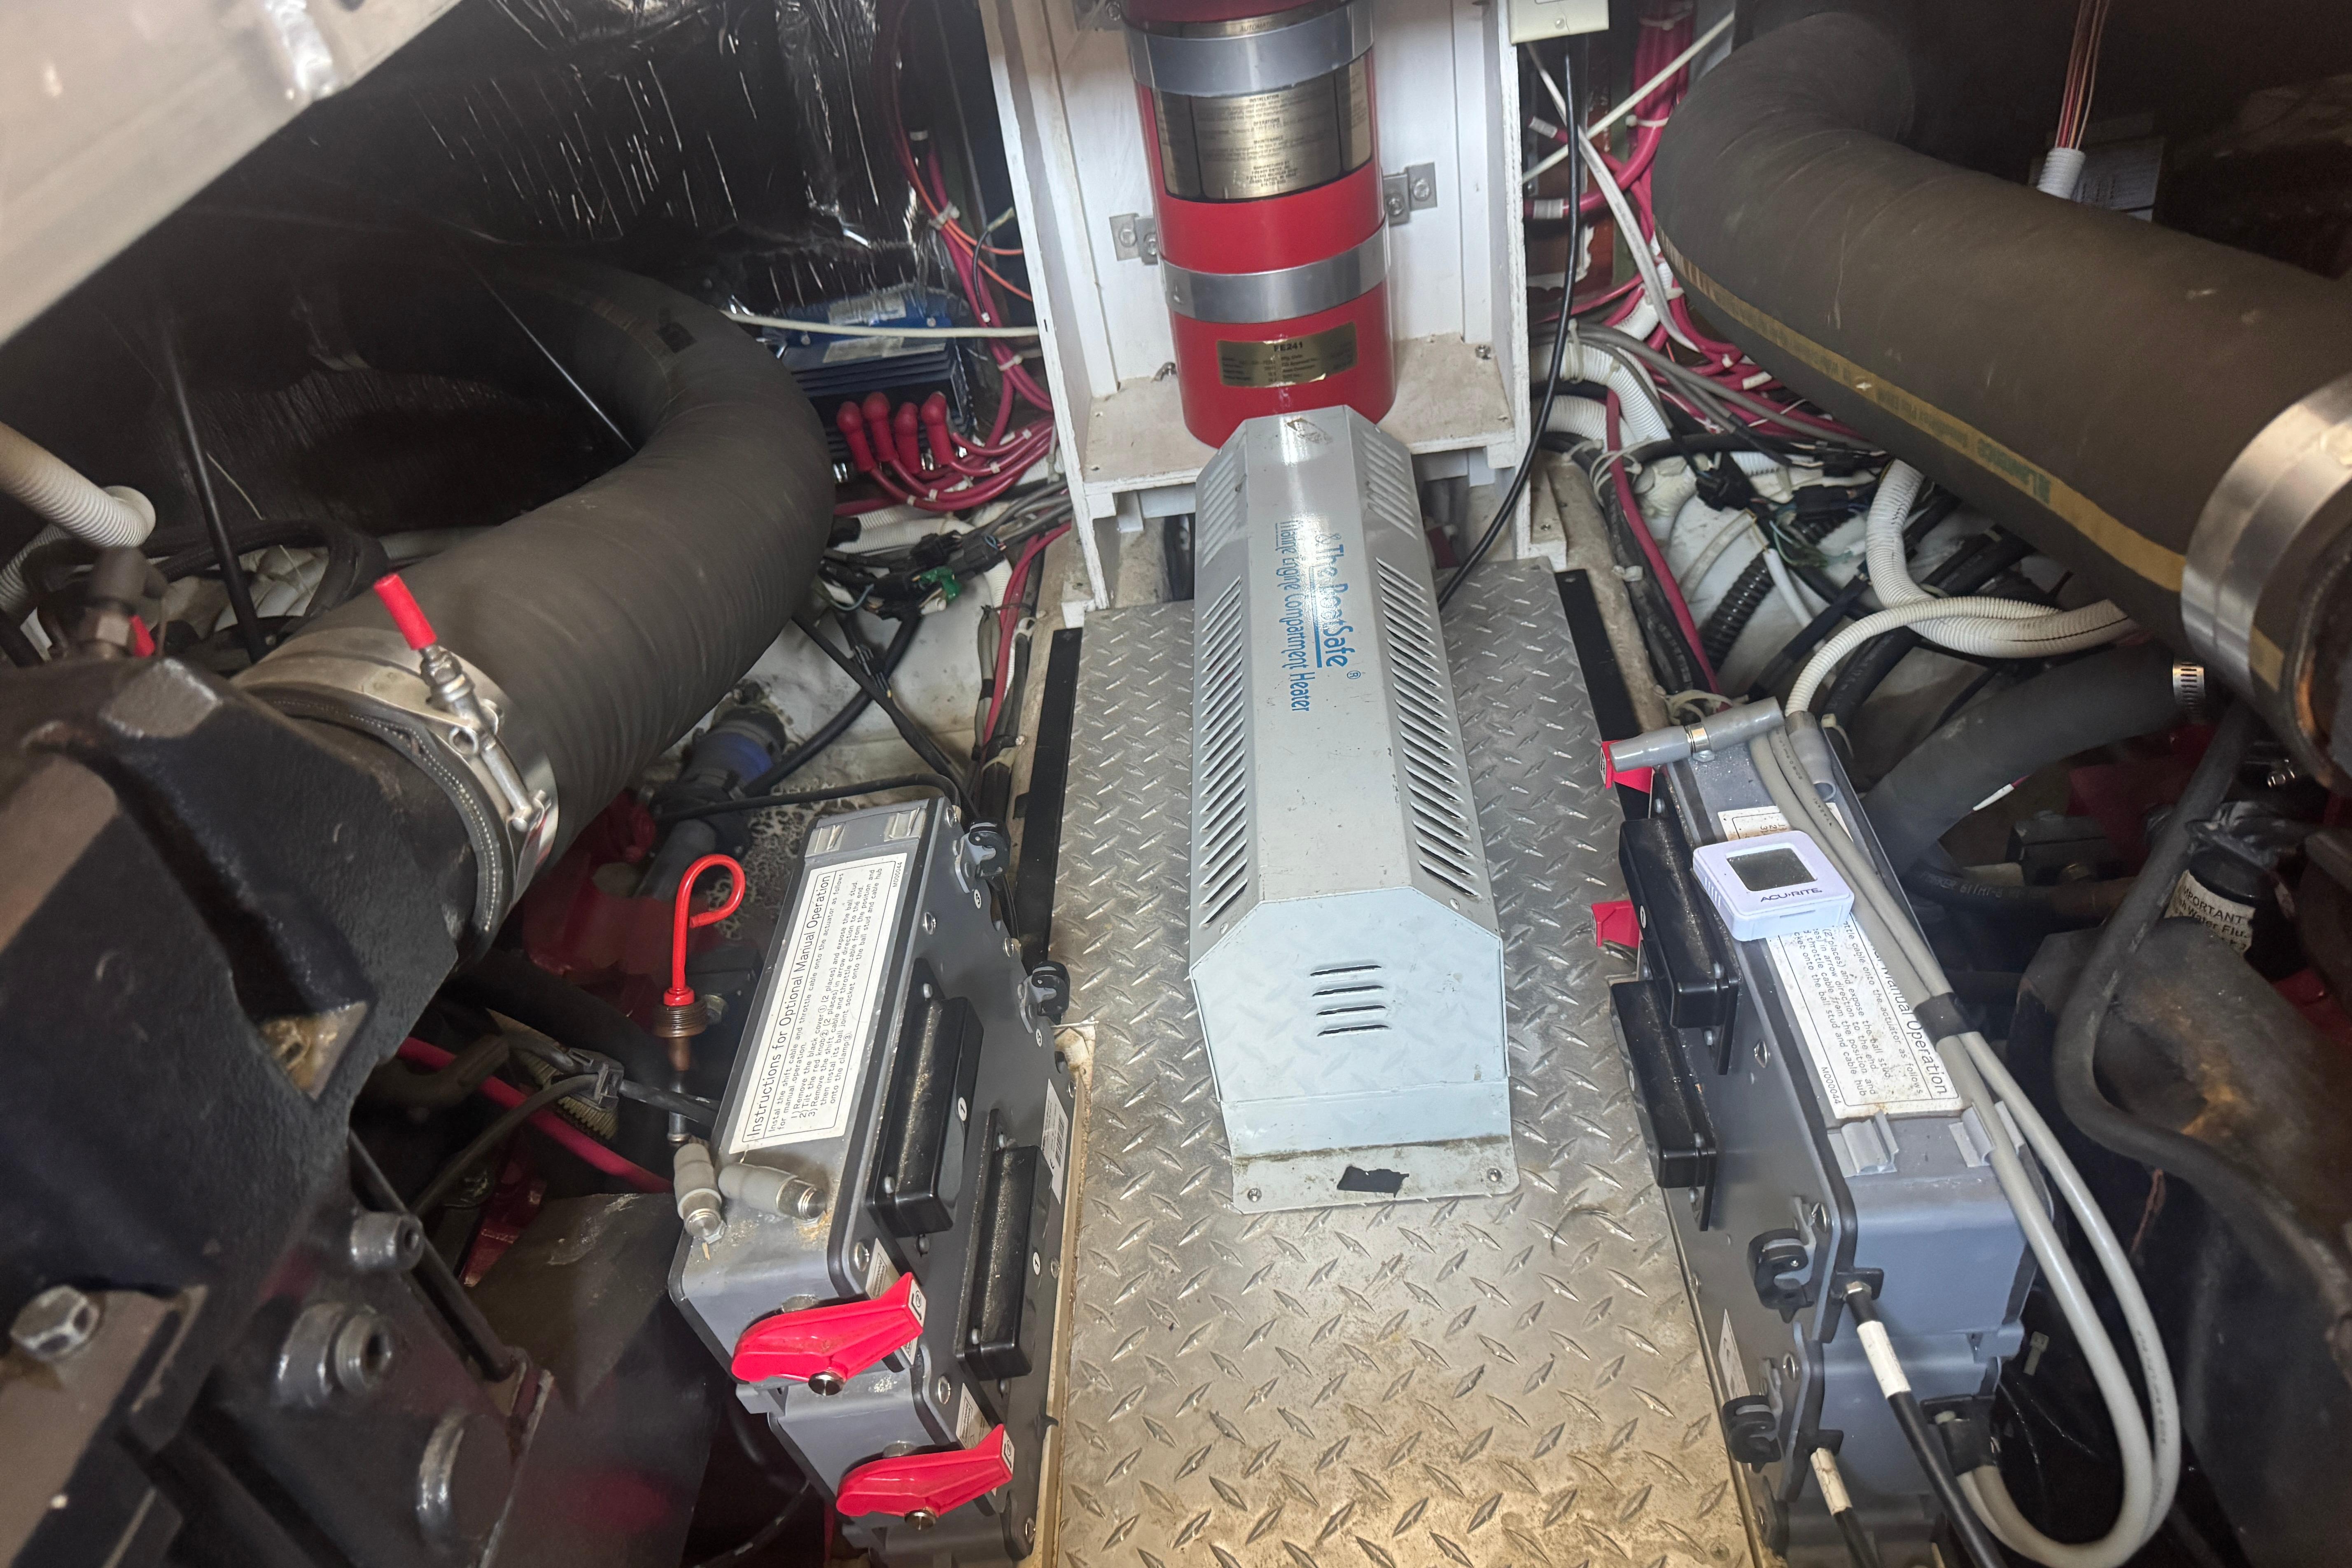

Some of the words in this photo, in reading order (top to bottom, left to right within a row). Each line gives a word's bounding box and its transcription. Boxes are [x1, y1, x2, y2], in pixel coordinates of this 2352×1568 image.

[1274, 341, 1303, 352] FE241
[1278, 594, 1309, 670] Compartment
[1289, 672, 1315, 712] Heater
[874, 868, 883, 880] hub
[892, 861, 903, 888] M000044
[832, 873, 844, 896] follows
[870, 882, 880, 899] cable
[806, 875, 831, 929] Operation
[831, 897, 838, 905] as
[844, 899, 854, 911] ball
[861, 883, 872, 909] position
[852, 901, 861, 912] the
[823, 908, 835, 936] actuator
[842, 913, 850, 925] the
[849, 915, 857, 923] to
[856, 911, 865, 923] the
[863, 916, 871, 931] stud
[836, 927, 847, 950] expose
[841, 925, 854, 955] direction
[851, 925, 862, 942] from
[858, 933, 867, 946] ball
[793, 931, 816, 973] Manual
[818, 939, 827, 951] the
[848, 944, 857, 962] cable
[855, 948, 864, 961] the
[1806, 937, 1825, 969] throttle
[814, 953, 823, 970] onto
[837, 958, 846, 978] arrow
[852, 963, 860, 980] onto
[808, 972, 818, 991] cable
[825, 967, 838, 992] places)
[839, 965, 852, 994] throttle
[1820, 972, 1835, 994] cable
[778, 975, 804, 1027] Optional
[826, 989, 839, 1015] places)
[836, 997, 844, 1010] and
[845, 982, 856, 1007] socket
[1823, 955, 1838, 977] arrow
[1834, 980, 1855, 1017] direction
[1852, 1021, 1861, 1031] to
[1857, 1035, 1869, 1050] the
[1825, 940, 1847, 968] places)
[1840, 970, 1854, 985] and
[1848, 988, 1865, 1017] expose
[1862, 1020, 1872, 1036] the
[1869, 1037, 1884, 1054] ball
[798, 994, 812, 1024] throttle
[1794, 931, 1806, 950] cket
[1802, 952, 1814, 971] onto
[1811, 973, 1822, 988] the
[1818, 991, 1832, 1006] ball
[1825, 1010, 1841, 1029] stud
[1834, 1032, 1849, 1048] and
[1843, 1051, 1858, 1075] cable
[1854, 1080, 1867, 1097] hub
[1829, 996, 1844, 1017] from
[831, 1013, 840, 1033] cable
[838, 1009, 849, 1027] joint
[1841, 1020, 1852, 1035] the
[1851, 943, 1867, 964] cable
[1862, 966, 1875, 985] onto
[1872, 989, 1883, 1003] the
[1880, 1006, 1902, 1045] actuator
[1898, 1048, 1908, 1059] as
[1904, 1062, 1923, 1094] follows
[771, 1030, 788, 1050] for
[795, 1027, 803, 1041] and
[834, 1029, 844, 1044] ball
[788, 1043, 799, 1064] cable
[806, 1037, 819, 1058] black
[824, 1036, 835, 1055] shift
[830, 1046, 840, 1058] its
[812, 1059, 821, 1073] red
[820, 1058, 829, 1072] the
[1846, 1038, 1868, 1074] position
[1906, 1020, 1948, 1095] Operation
[781, 1067, 792, 1087] shift
[803, 1061, 812, 1075] the
[826, 1061, 837, 1083] instal
[834, 1067, 843, 1082] the
[807, 1076, 817, 1090] the
[1821, 1066, 1842, 1105] M000044
[1864, 1078, 1879, 1095] and
[746, 1054, 782, 1137] Instructions
[776, 1090, 786, 1105] the
[801, 1093, 813, 1109] Tilt
[819, 1087, 831, 1106] then
[830, 1085, 839, 1104] onto
[777, 1117, 787, 1130] for
[783, 1085, 796, 1113] manual
[768, 1108, 781, 1132] Instal
